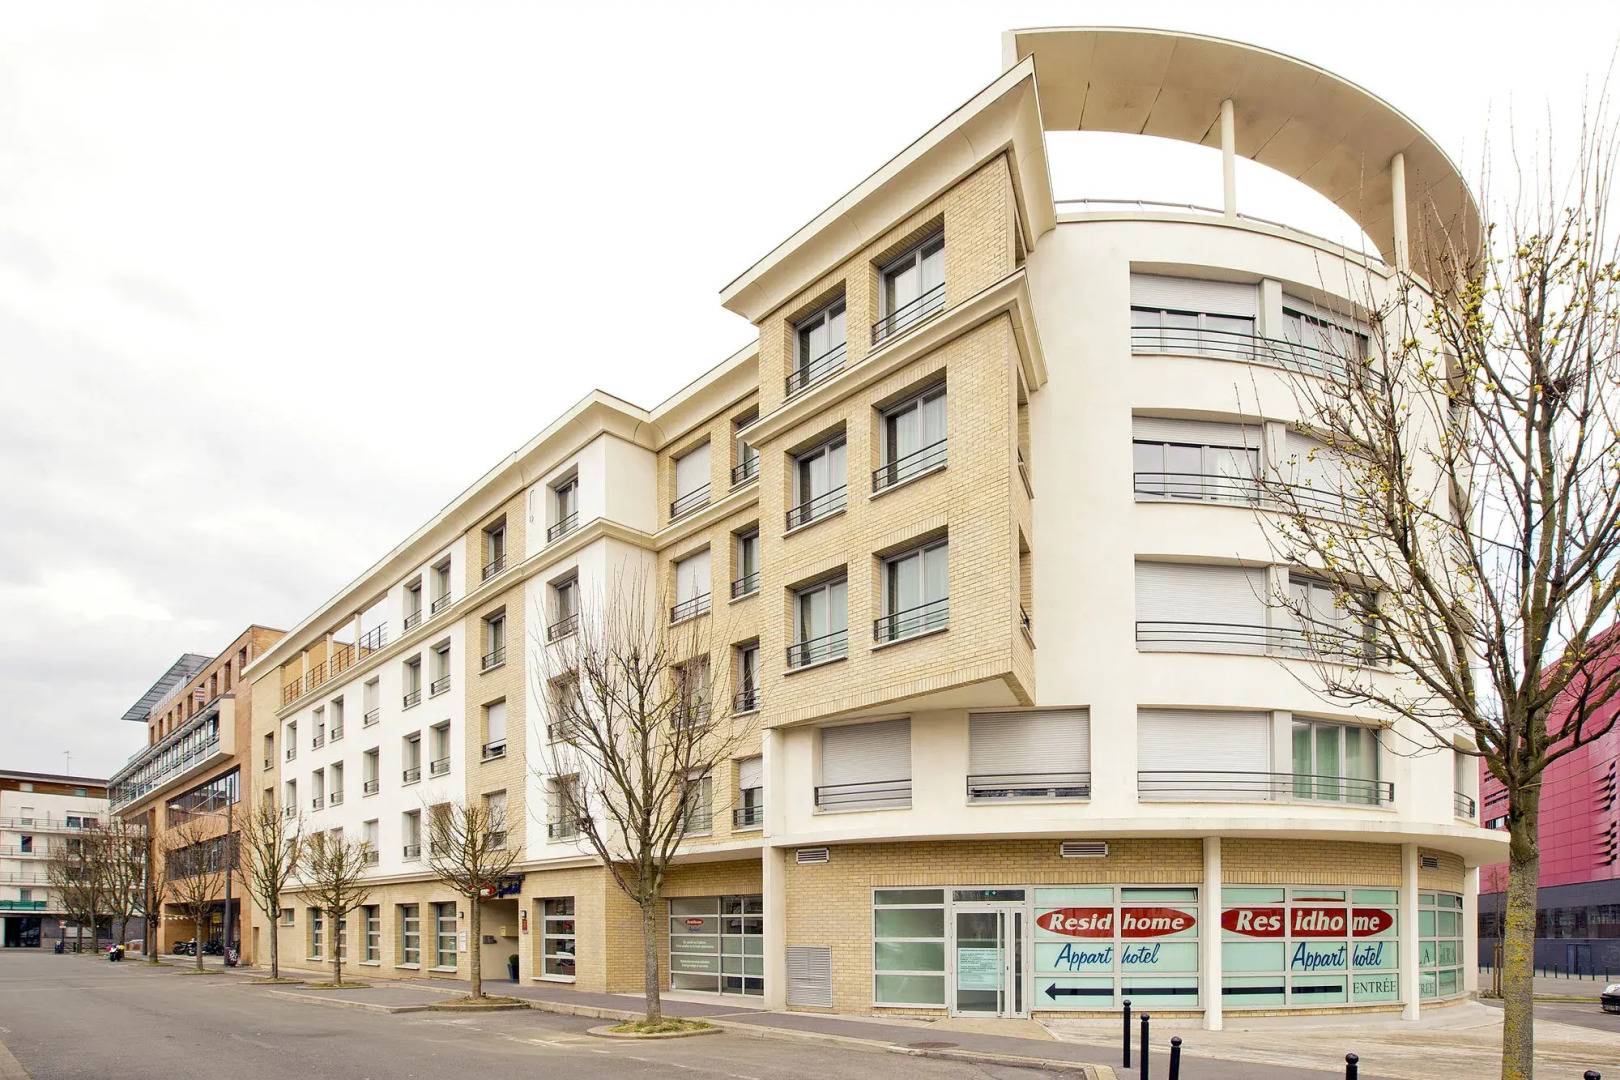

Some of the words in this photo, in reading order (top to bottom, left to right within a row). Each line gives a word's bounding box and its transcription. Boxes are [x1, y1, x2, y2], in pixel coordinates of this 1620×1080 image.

[1048, 912, 1185, 930] Residhome
[1235, 910, 1380, 931] Residhome
[1353, 978, 1397, 994] ENTRÉE
